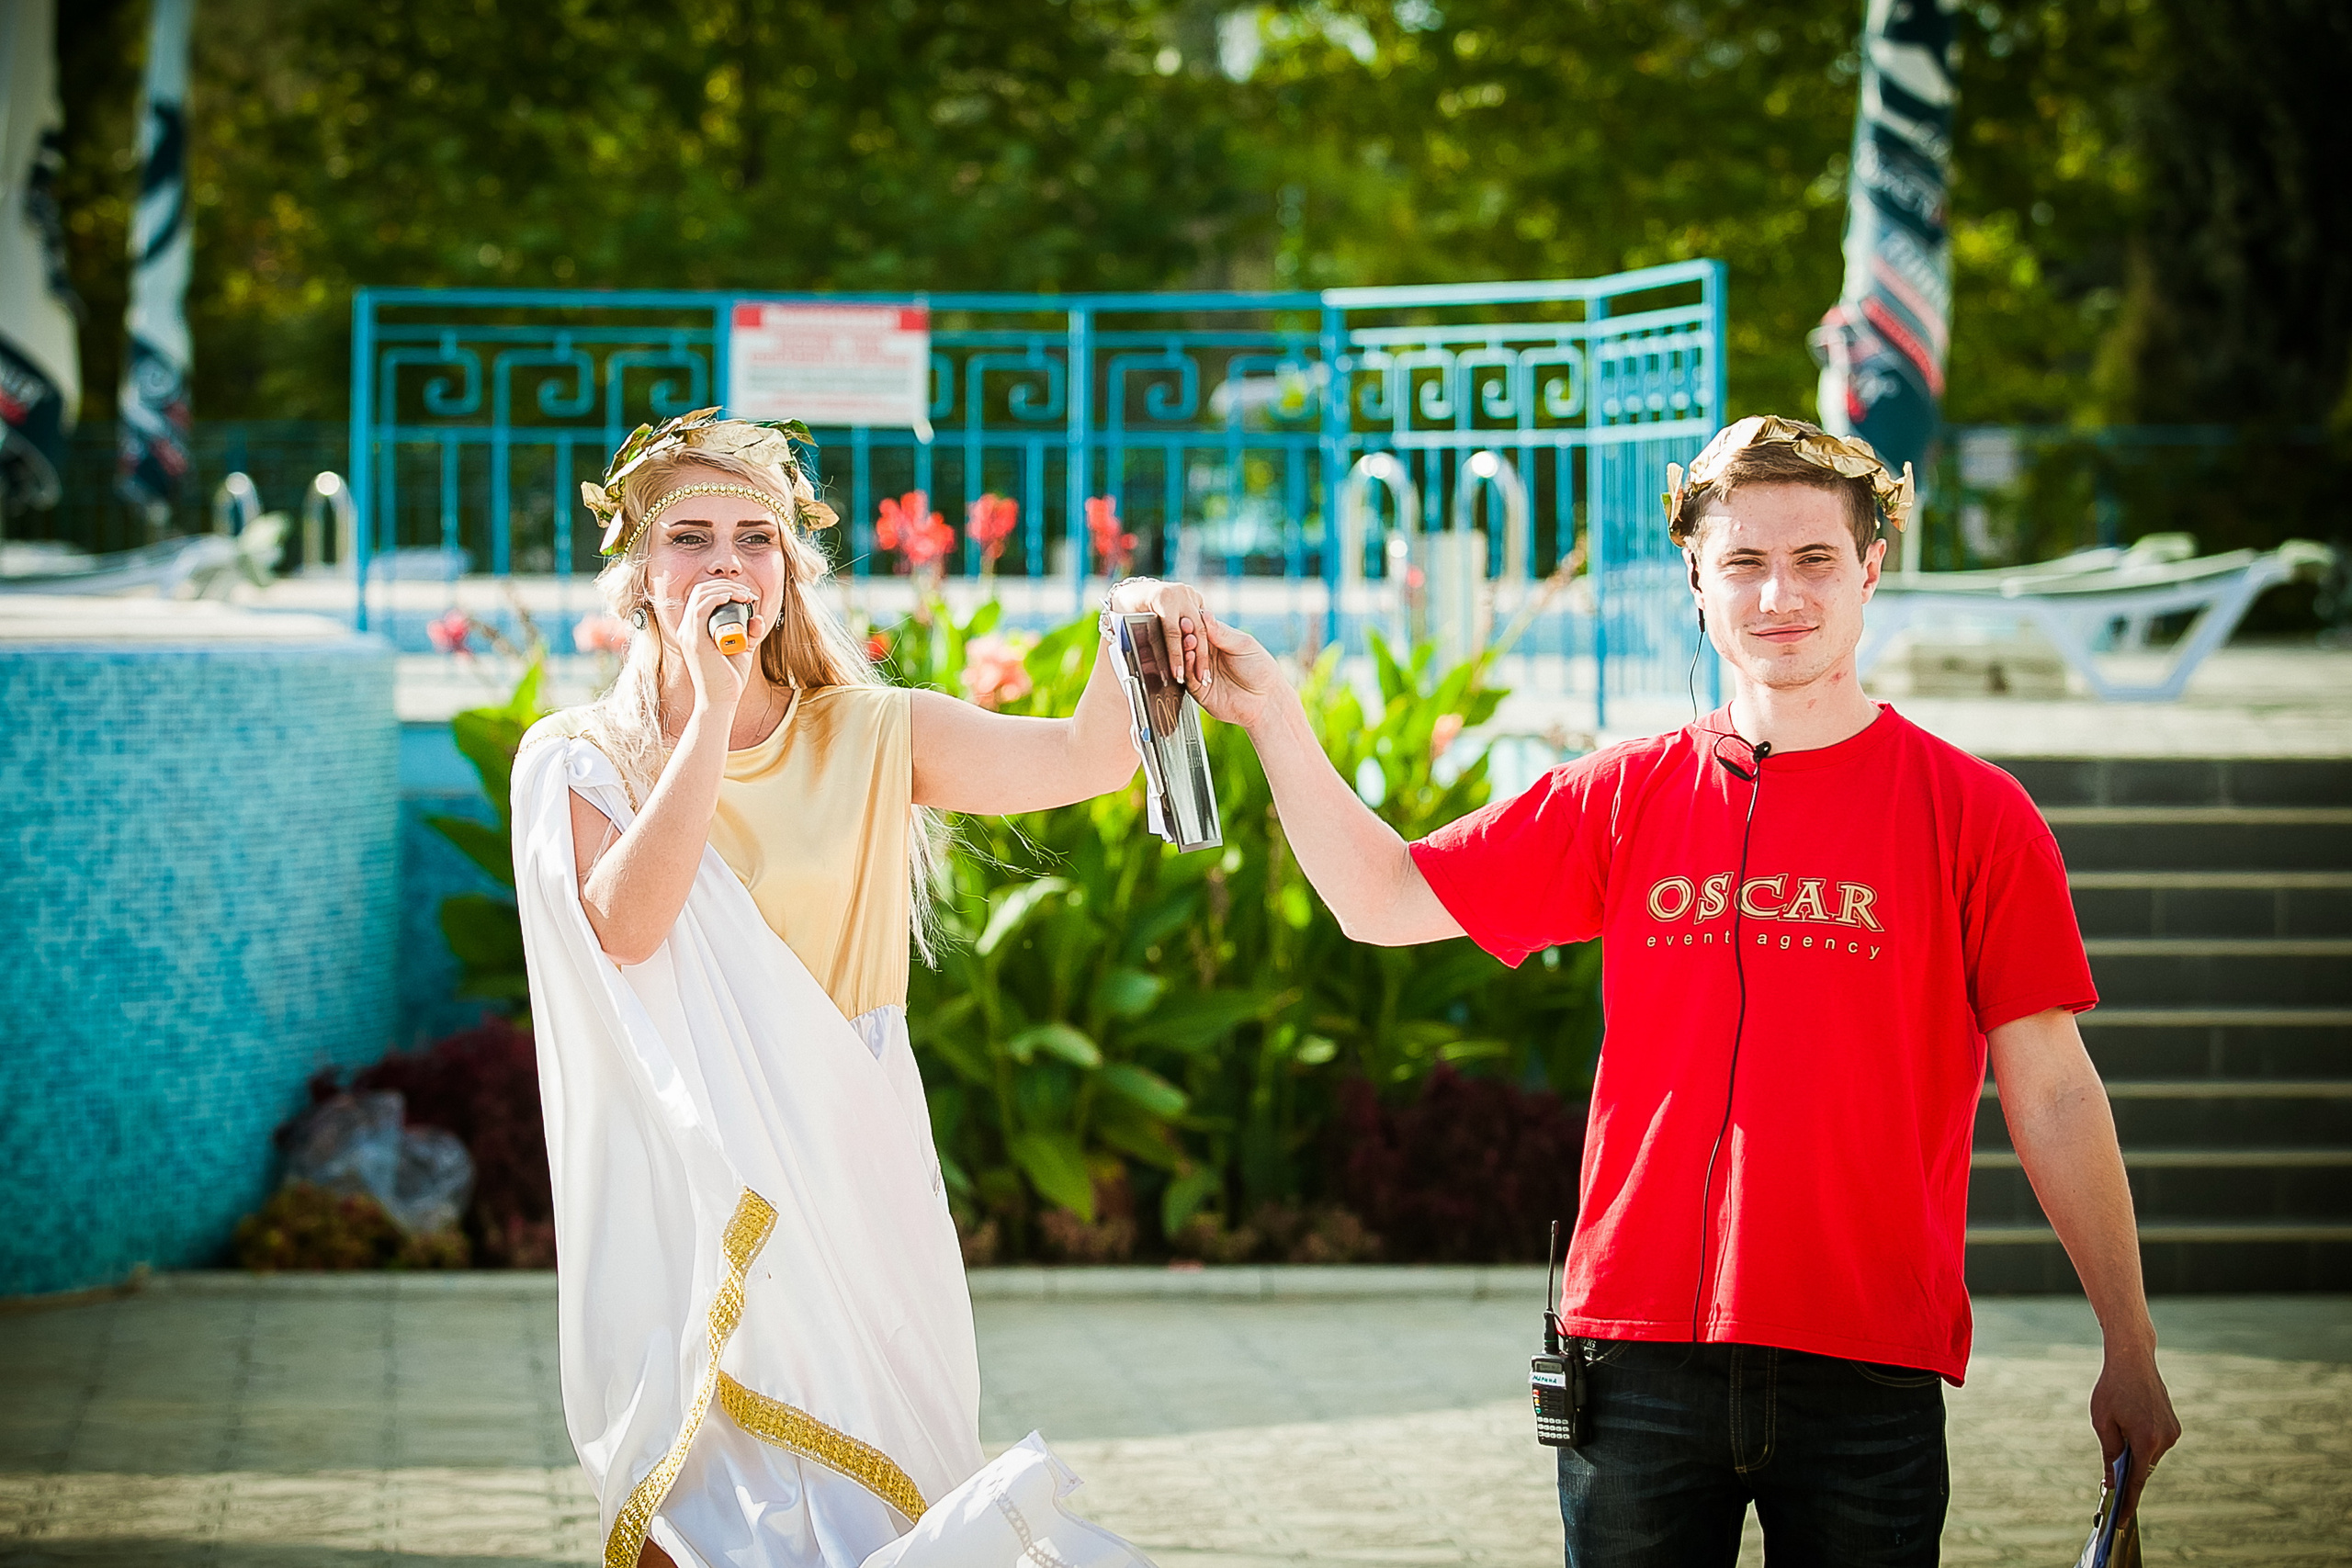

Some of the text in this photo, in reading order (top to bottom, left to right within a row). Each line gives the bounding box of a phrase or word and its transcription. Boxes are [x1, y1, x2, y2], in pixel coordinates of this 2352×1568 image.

[1646, 872, 1884, 932] OSCAR
[1646, 930, 1881, 960] event agency
